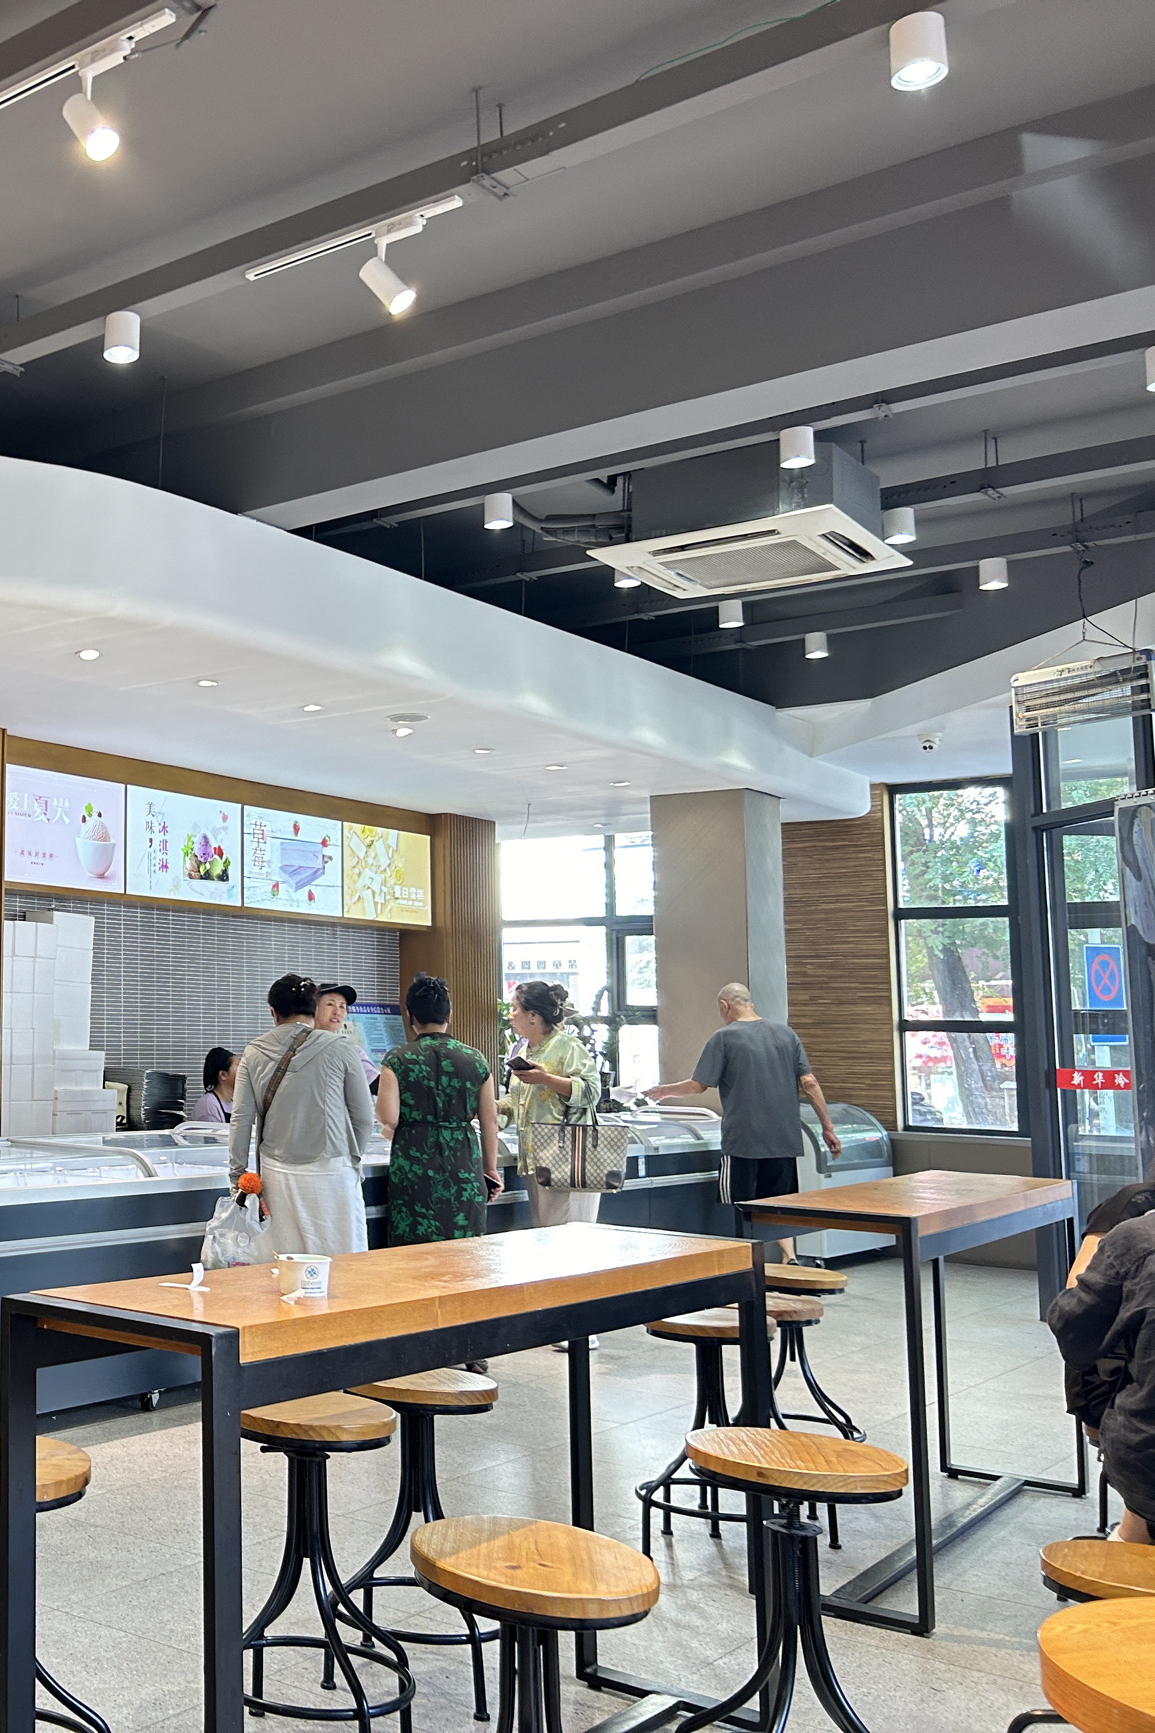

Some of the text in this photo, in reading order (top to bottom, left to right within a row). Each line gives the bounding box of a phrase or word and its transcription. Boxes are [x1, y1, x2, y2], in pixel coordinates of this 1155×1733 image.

[158, 821, 169, 873] 冰淇淋
[250, 820, 266, 870] 草莓
